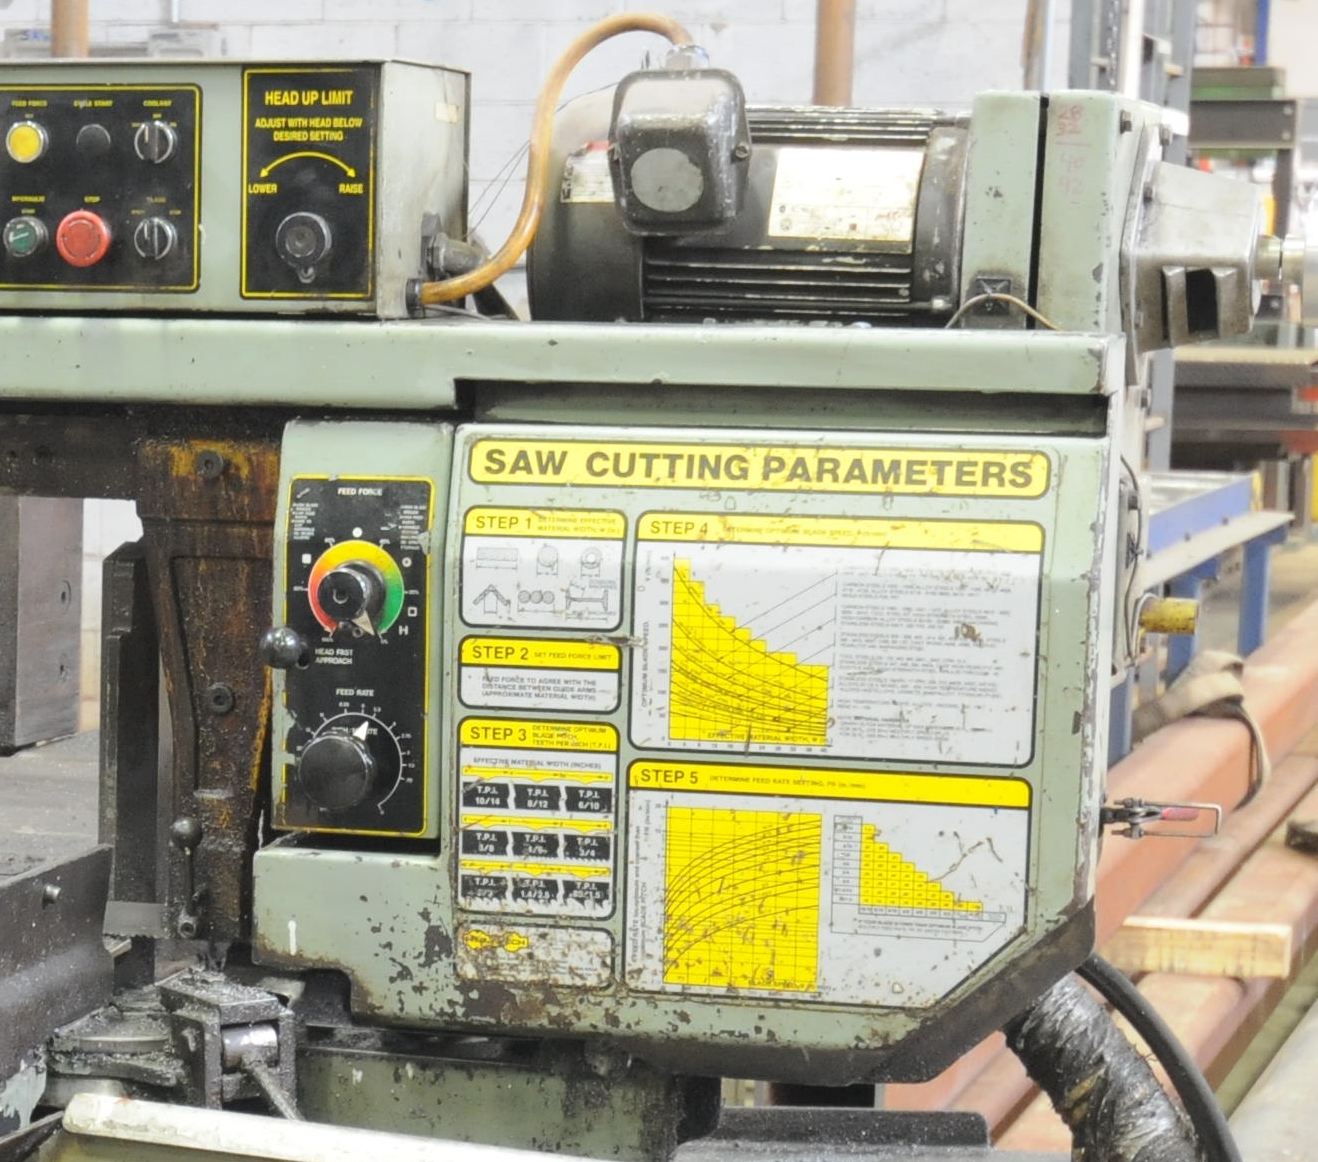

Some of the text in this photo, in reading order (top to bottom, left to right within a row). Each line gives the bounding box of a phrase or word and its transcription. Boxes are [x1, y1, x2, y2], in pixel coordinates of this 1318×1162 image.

[265, 90, 353, 105] HEAD UP LIMIT
[255, 118, 363, 128] ADJUST WITH HEAD BELOW
[273, 131, 308, 141] DESIRED
[248, 184, 277, 194] LOWER
[339, 184, 363, 194] RAISE
[484, 449, 1032, 488] SAW CUTTING PARAMETERS
[337, 488, 382, 496] FEED FORCE
[476, 516, 532, 530] STEP 1
[650, 520, 695, 534] STEP
[699, 522, 708, 534] 4
[472, 646, 515, 660] STEP
[520, 647, 529, 660] 2
[315, 657, 353, 665] APPROACH
[502, 676, 524, 684] FORCE
[564, 678, 581, 686] WITH
[336, 688, 374, 697] FEED RATE
[518, 684, 552, 692] BETWEEN
[470, 726, 514, 741] STEP
[518, 728, 527, 742] 3
[532, 724, 572, 732] DETERMINE
[641, 768, 684, 784] STEP
[690, 771, 699, 784] 5
[527, 800, 548, 808] 8/12
[578, 801, 600, 810] 6/10
